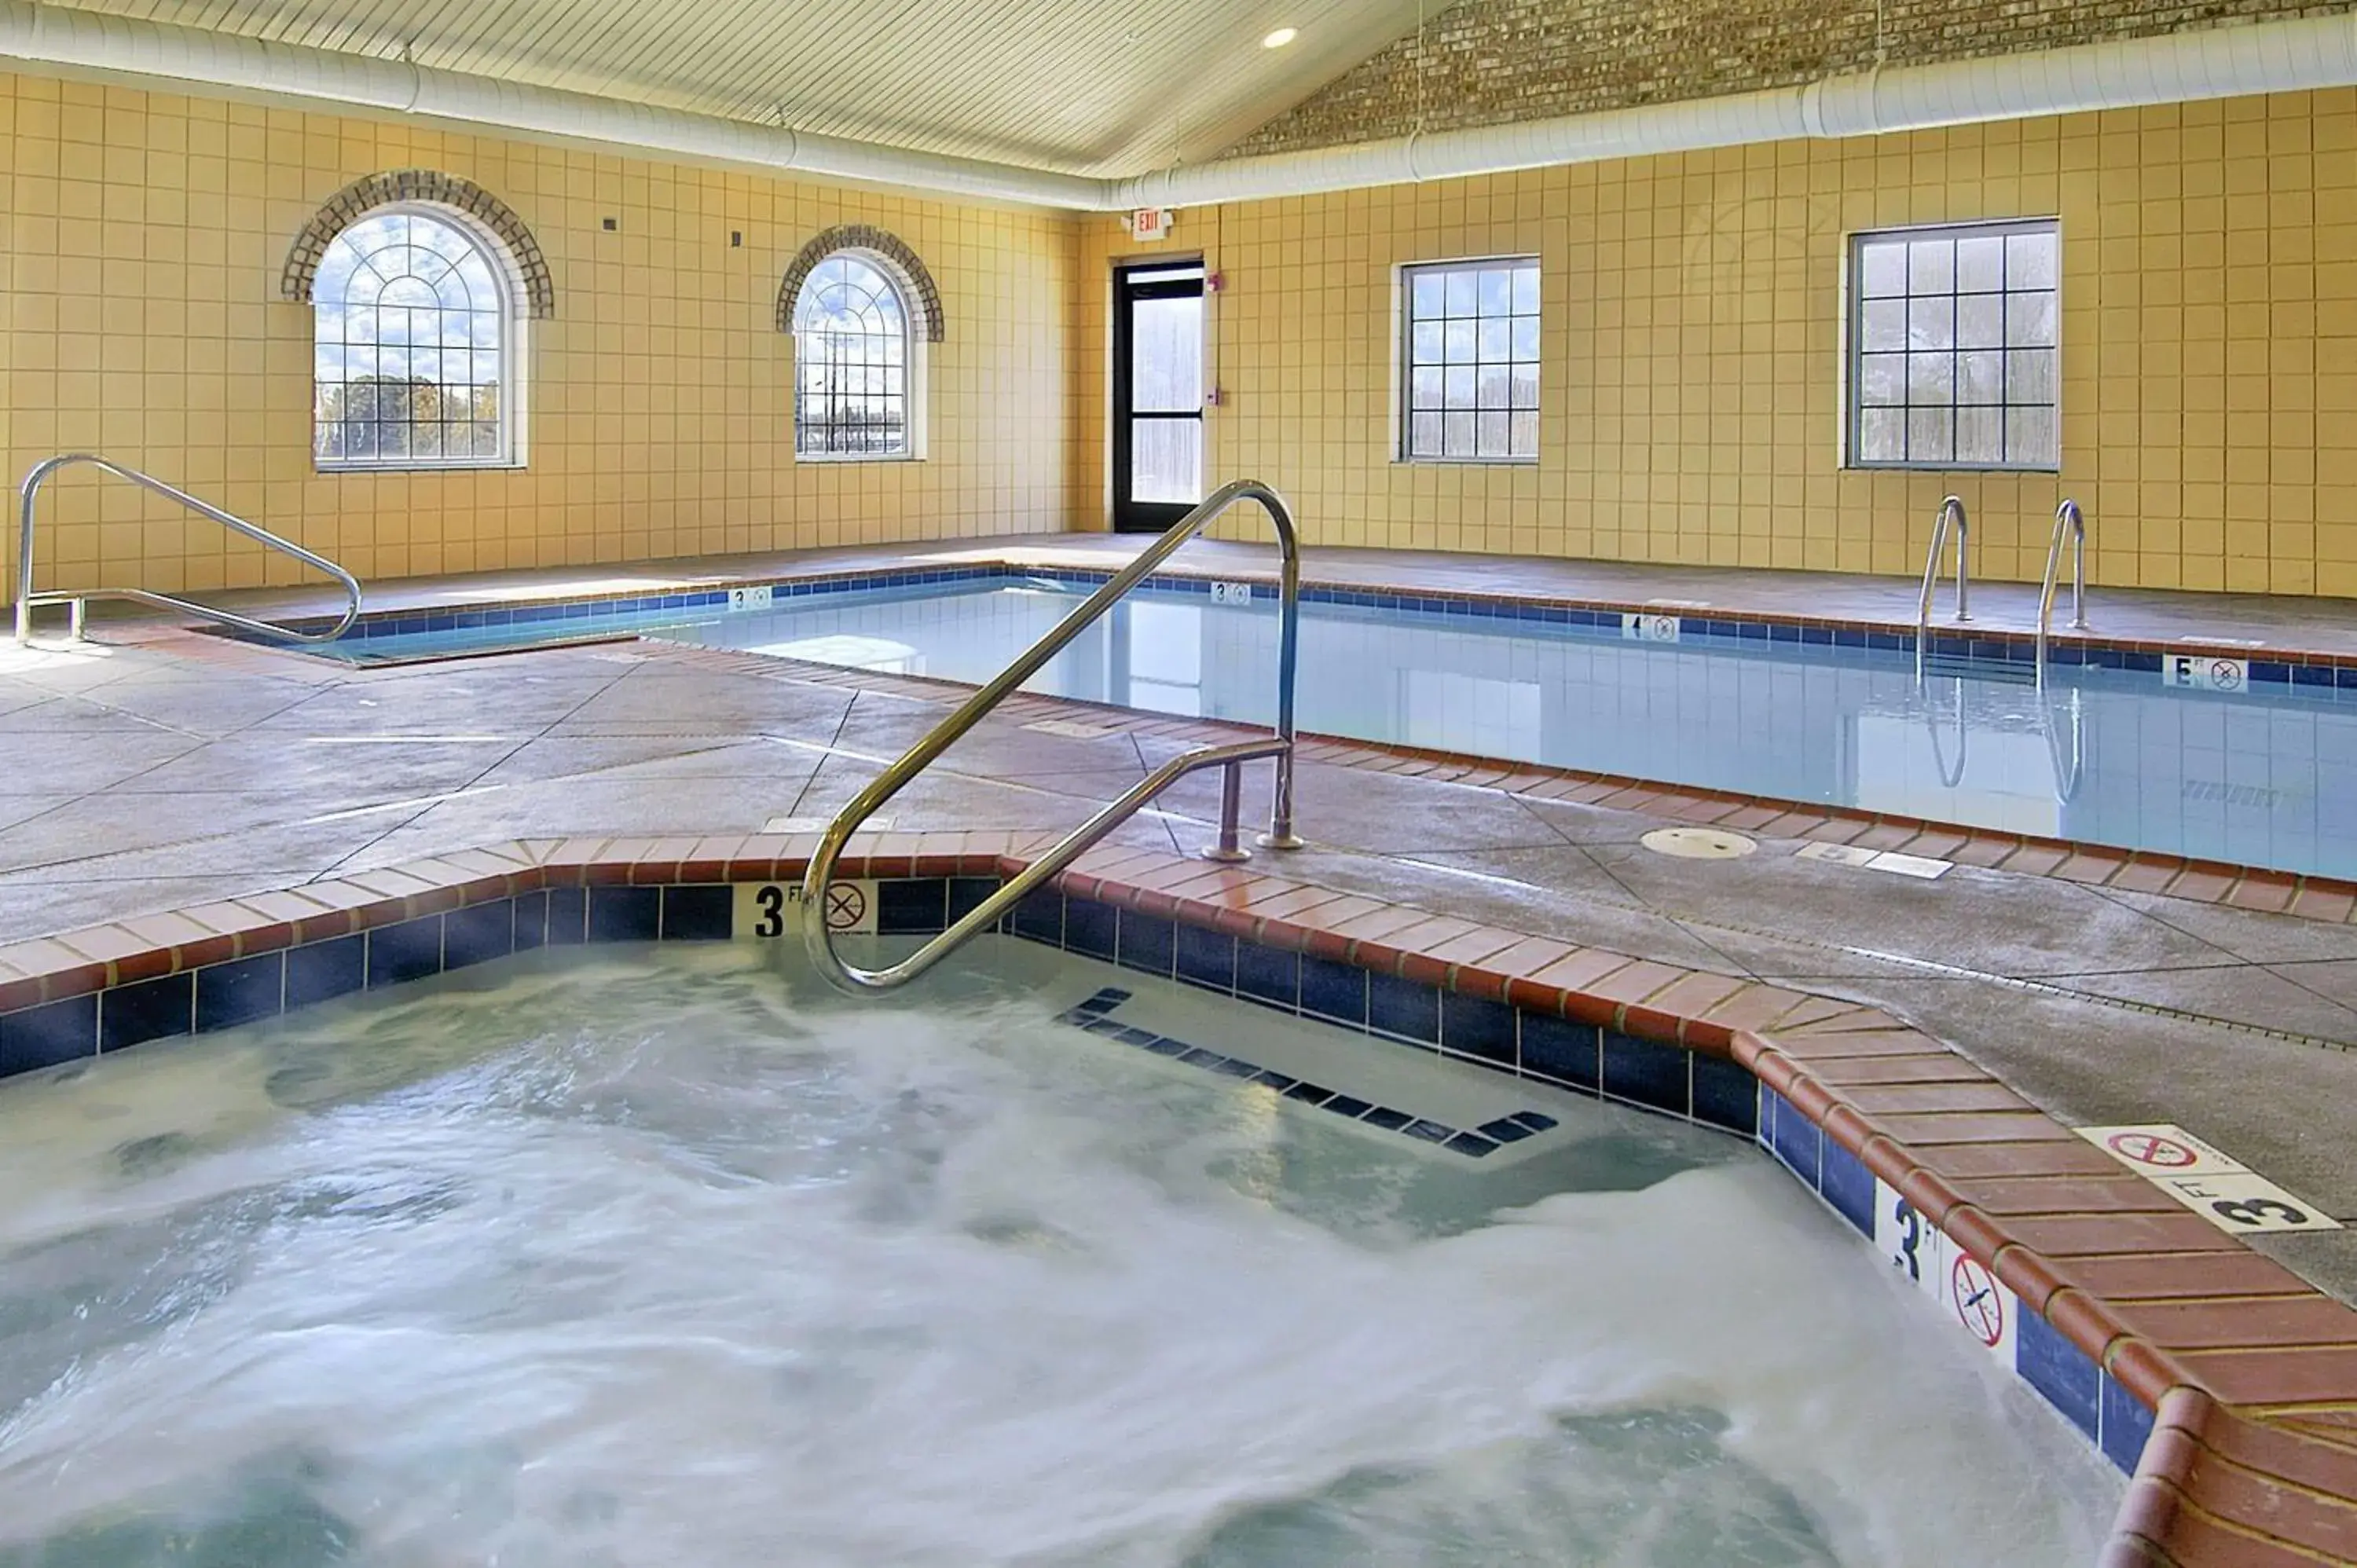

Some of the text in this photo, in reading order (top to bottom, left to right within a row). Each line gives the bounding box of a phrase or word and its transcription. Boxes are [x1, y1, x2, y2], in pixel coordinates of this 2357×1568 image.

[1139, 211, 1159, 232] EXIT
[755, 885, 804, 937] 3 FT
[2172, 1180, 2308, 1225] 3 FT
[1894, 1197, 1919, 1282] 3
